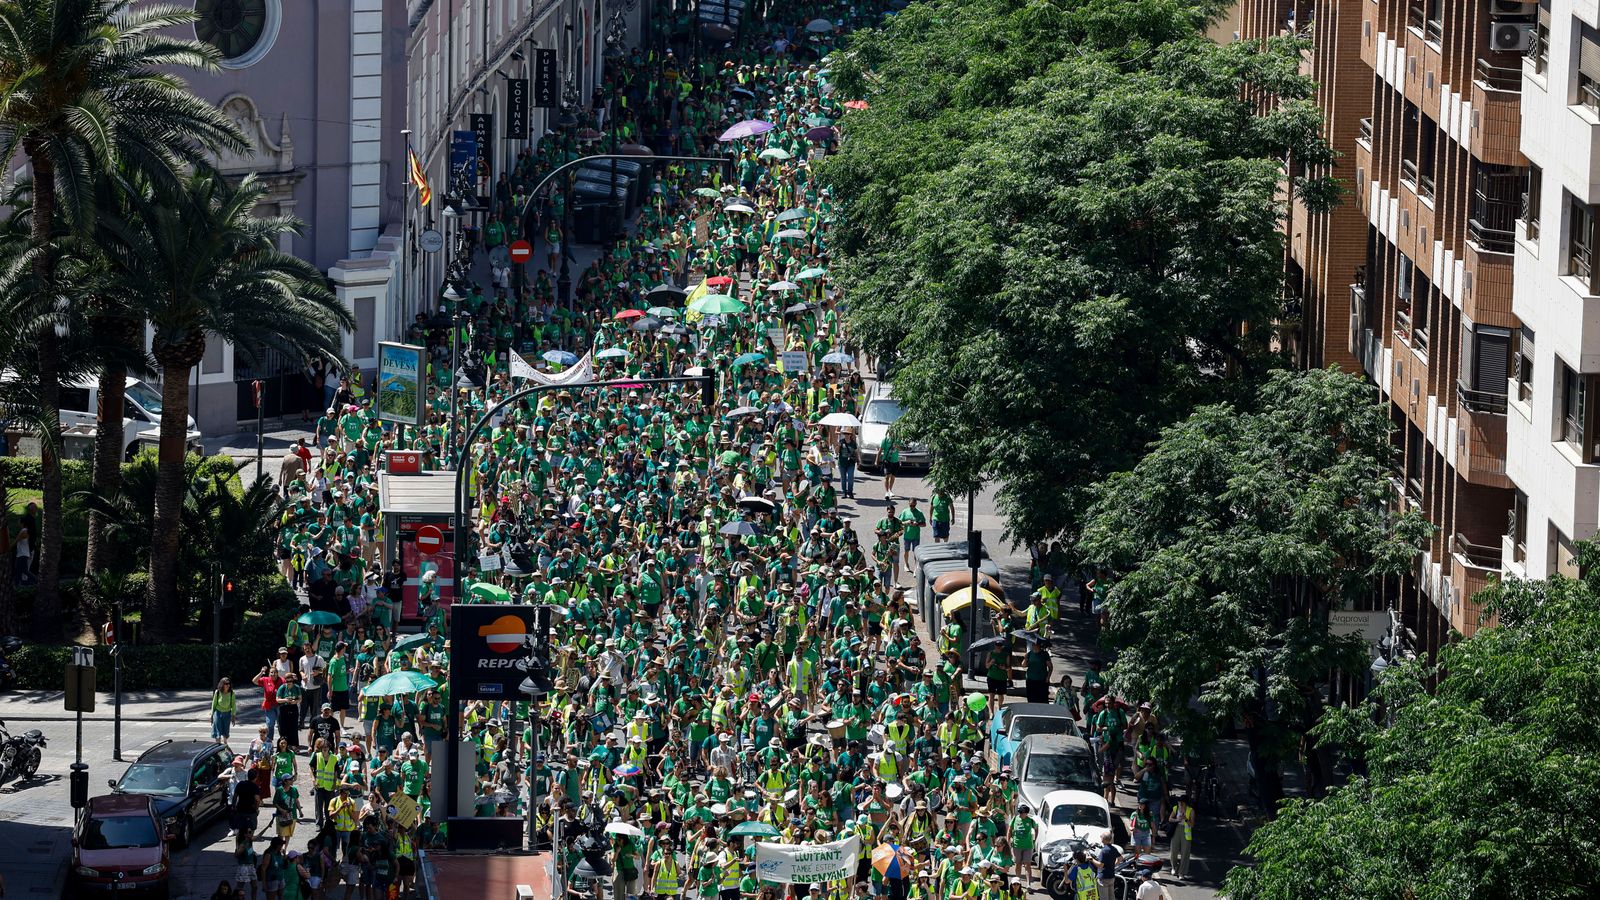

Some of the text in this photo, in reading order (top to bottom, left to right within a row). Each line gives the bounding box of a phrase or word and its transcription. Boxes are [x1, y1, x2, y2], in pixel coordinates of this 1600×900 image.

[542, 52, 550, 101] PUERTAS
[513, 81, 522, 134] COCINAS
[476, 117, 486, 168] ARMARIOS
[383, 358, 416, 371] DEVESA
[1332, 614, 1369, 624] Arqproval
[477, 658, 528, 669] REPSO
[815, 863, 836, 872] ESTEM
